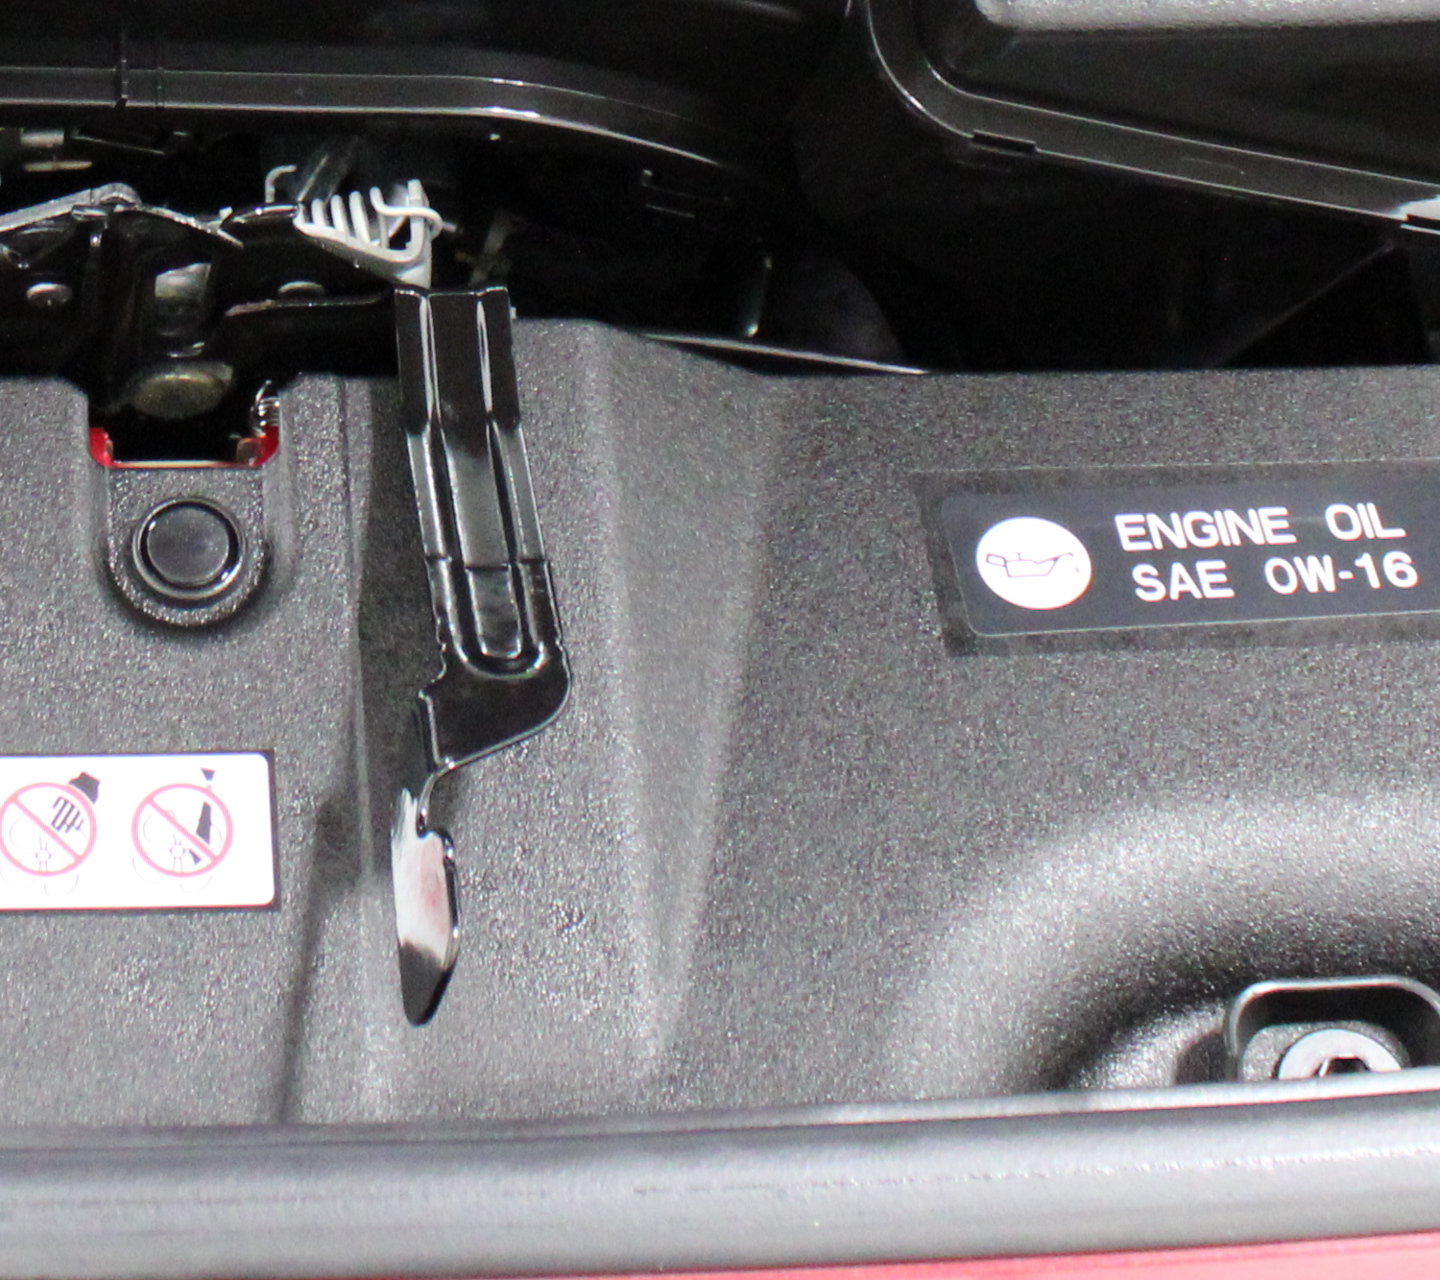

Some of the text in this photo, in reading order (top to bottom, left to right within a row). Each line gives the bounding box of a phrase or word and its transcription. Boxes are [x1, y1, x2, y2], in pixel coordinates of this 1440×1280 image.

[1114, 502, 1407, 552] ENGINE OIL
[1132, 550, 1419, 602] SAE 0W-16
